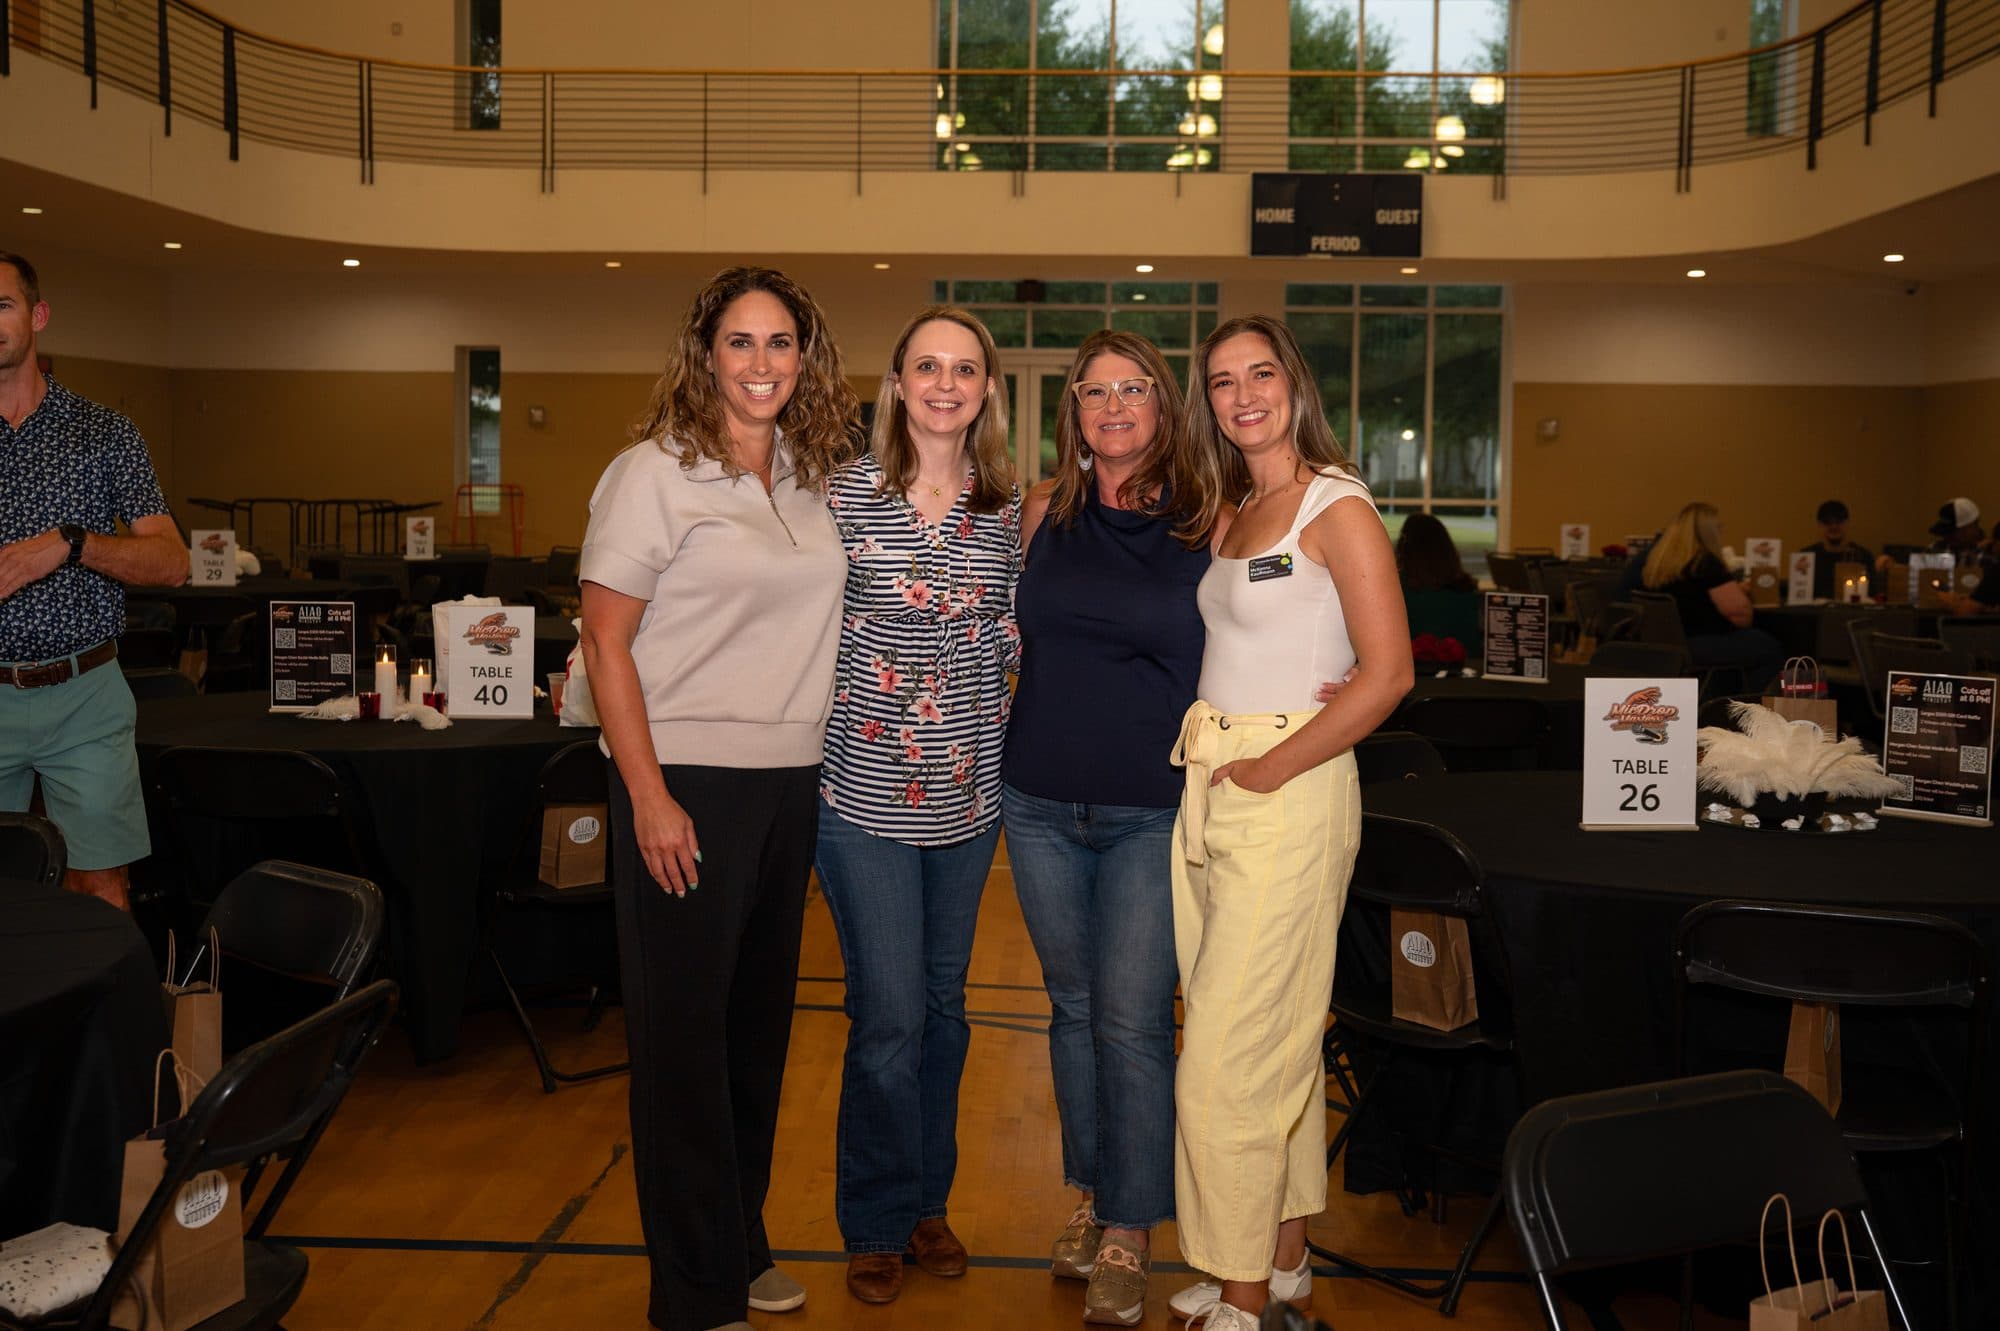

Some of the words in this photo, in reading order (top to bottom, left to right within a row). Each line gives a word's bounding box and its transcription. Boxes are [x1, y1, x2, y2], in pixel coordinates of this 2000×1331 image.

[1255, 208, 1295, 223] HOME
[1375, 209, 1420, 225] GUEST
[1311, 236, 1361, 251] PERIOD
[206, 569, 222, 580] 29
[470, 666, 513, 679] TABLE
[473, 684, 508, 706] 40
[1960, 686, 1979, 696] Cuts
[1980, 687, 1992, 697] off
[1612, 760, 1669, 775] TABLE
[1619, 784, 1661, 812] 26
